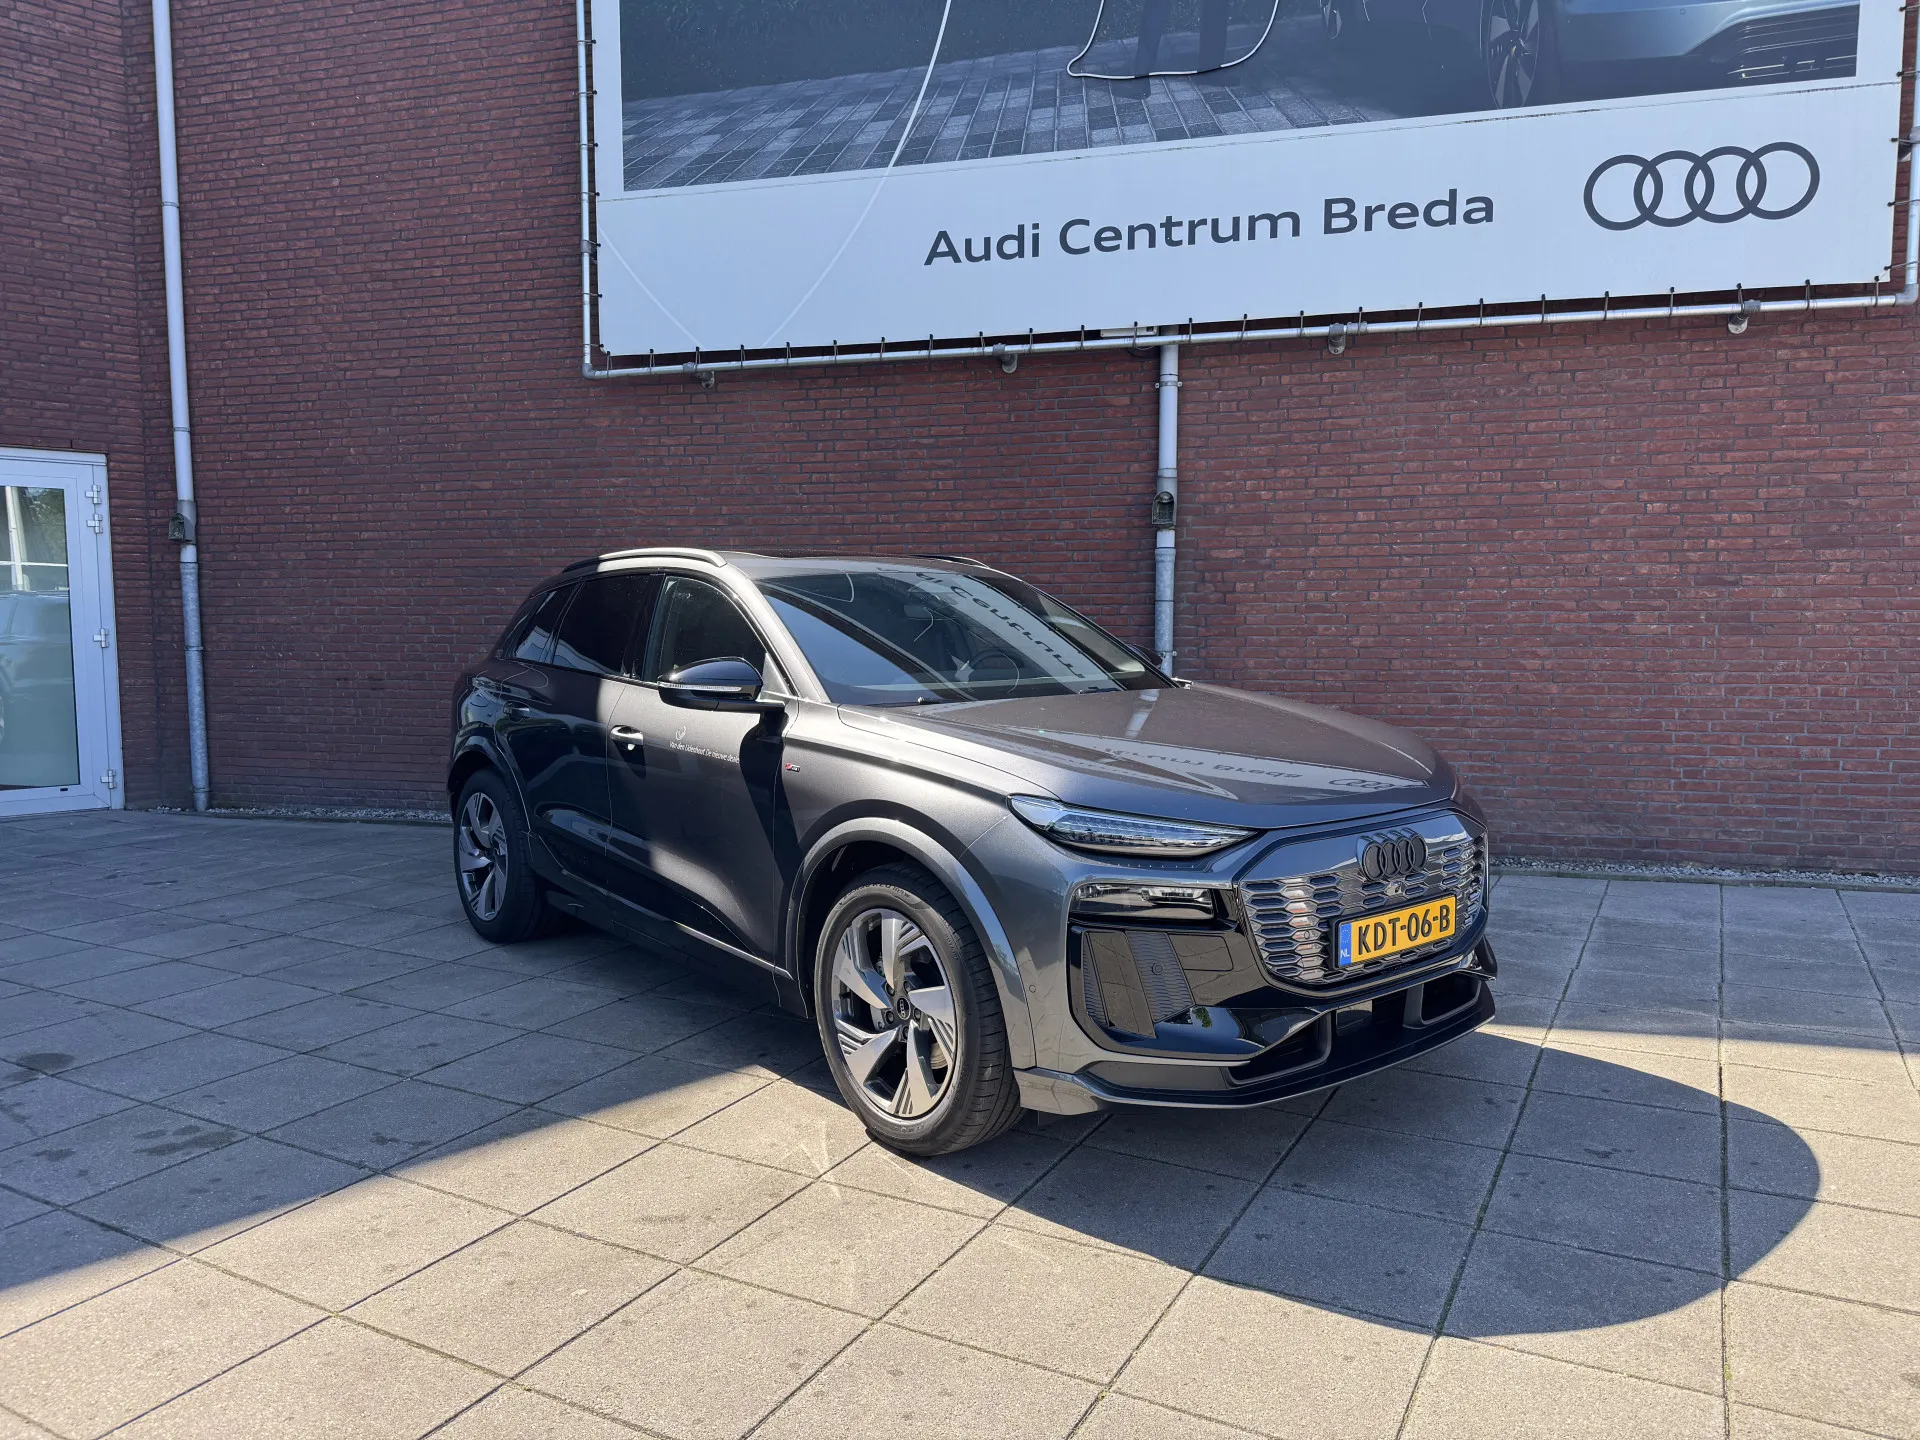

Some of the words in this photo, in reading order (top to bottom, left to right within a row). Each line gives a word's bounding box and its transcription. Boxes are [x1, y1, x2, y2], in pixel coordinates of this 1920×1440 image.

[923, 222, 1041, 266] Audi
[1059, 211, 1301, 255] Centrum
[1323, 188, 1495, 235] Breda
[1340, 948, 1350, 958] NL
[1358, 904, 1450, 956] KDT-06-B
